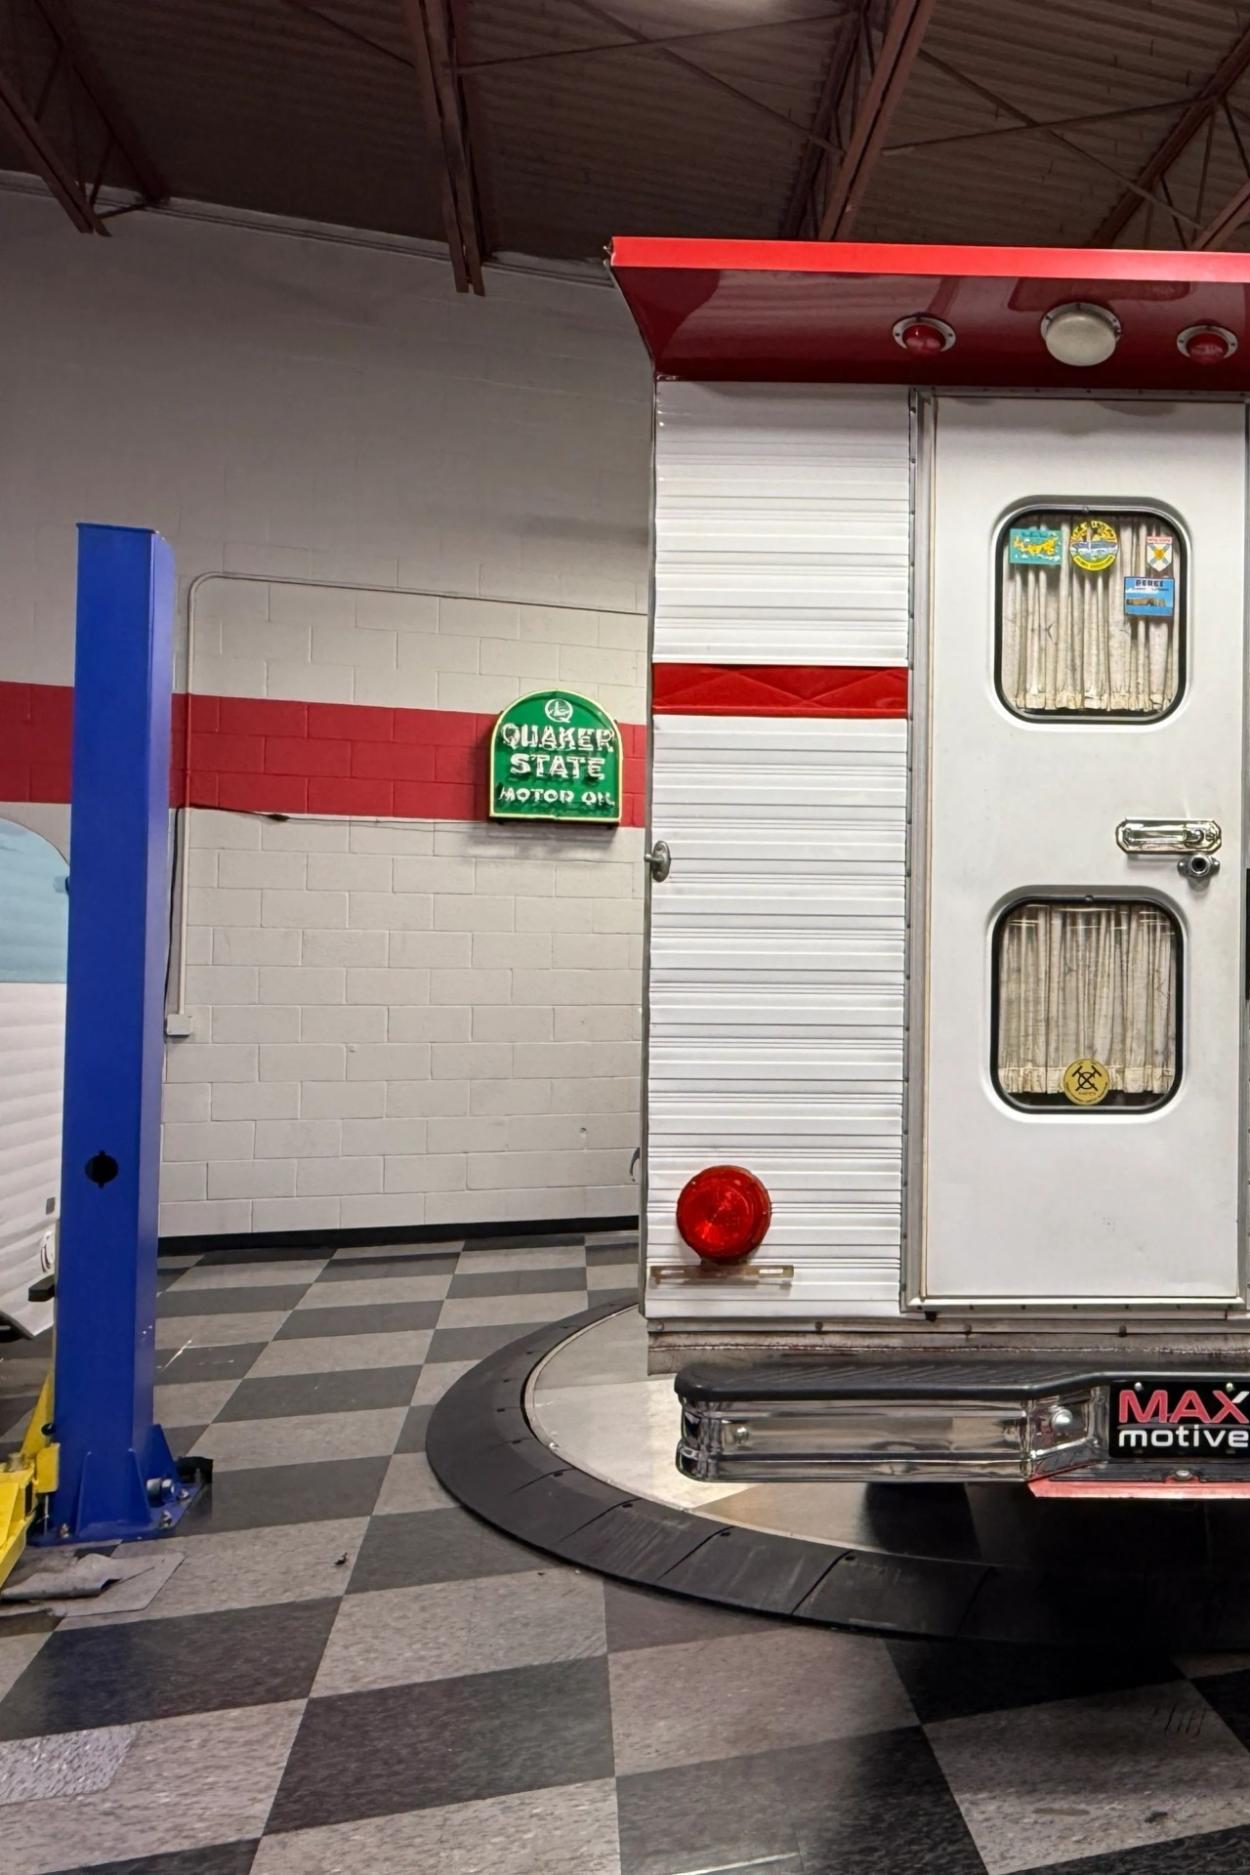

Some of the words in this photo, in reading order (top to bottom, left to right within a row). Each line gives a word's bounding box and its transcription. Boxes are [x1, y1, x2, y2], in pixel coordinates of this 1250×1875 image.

[501, 723, 615, 752] QUAKER
[510, 753, 605, 780] STATE
[499, 786, 575, 804] MOTOR
[581, 791, 616, 806] OIL
[1118, 1389, 1250, 1424] MAX
[1118, 1424, 1250, 1448] motive
